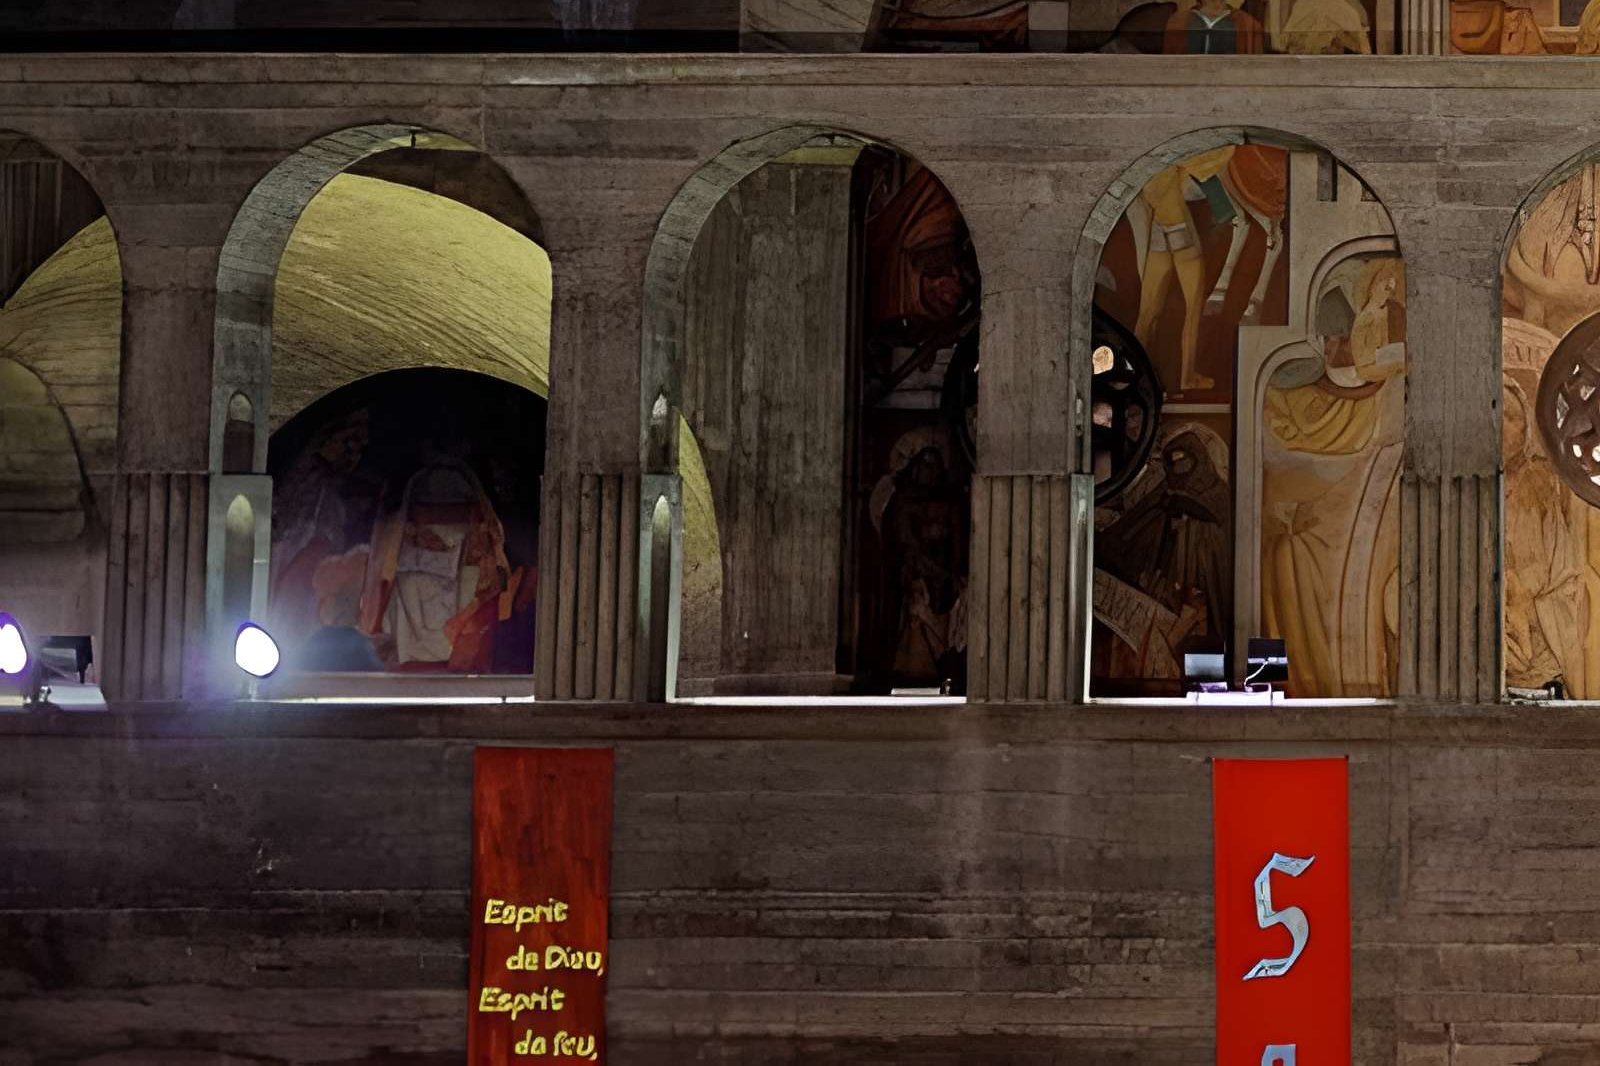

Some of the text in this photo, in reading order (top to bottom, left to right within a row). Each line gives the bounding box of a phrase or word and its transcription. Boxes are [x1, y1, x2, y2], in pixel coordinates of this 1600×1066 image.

[484, 898, 568, 932] Esprit
[506, 945, 539, 970] de
[479, 986, 565, 1020] Esprit
